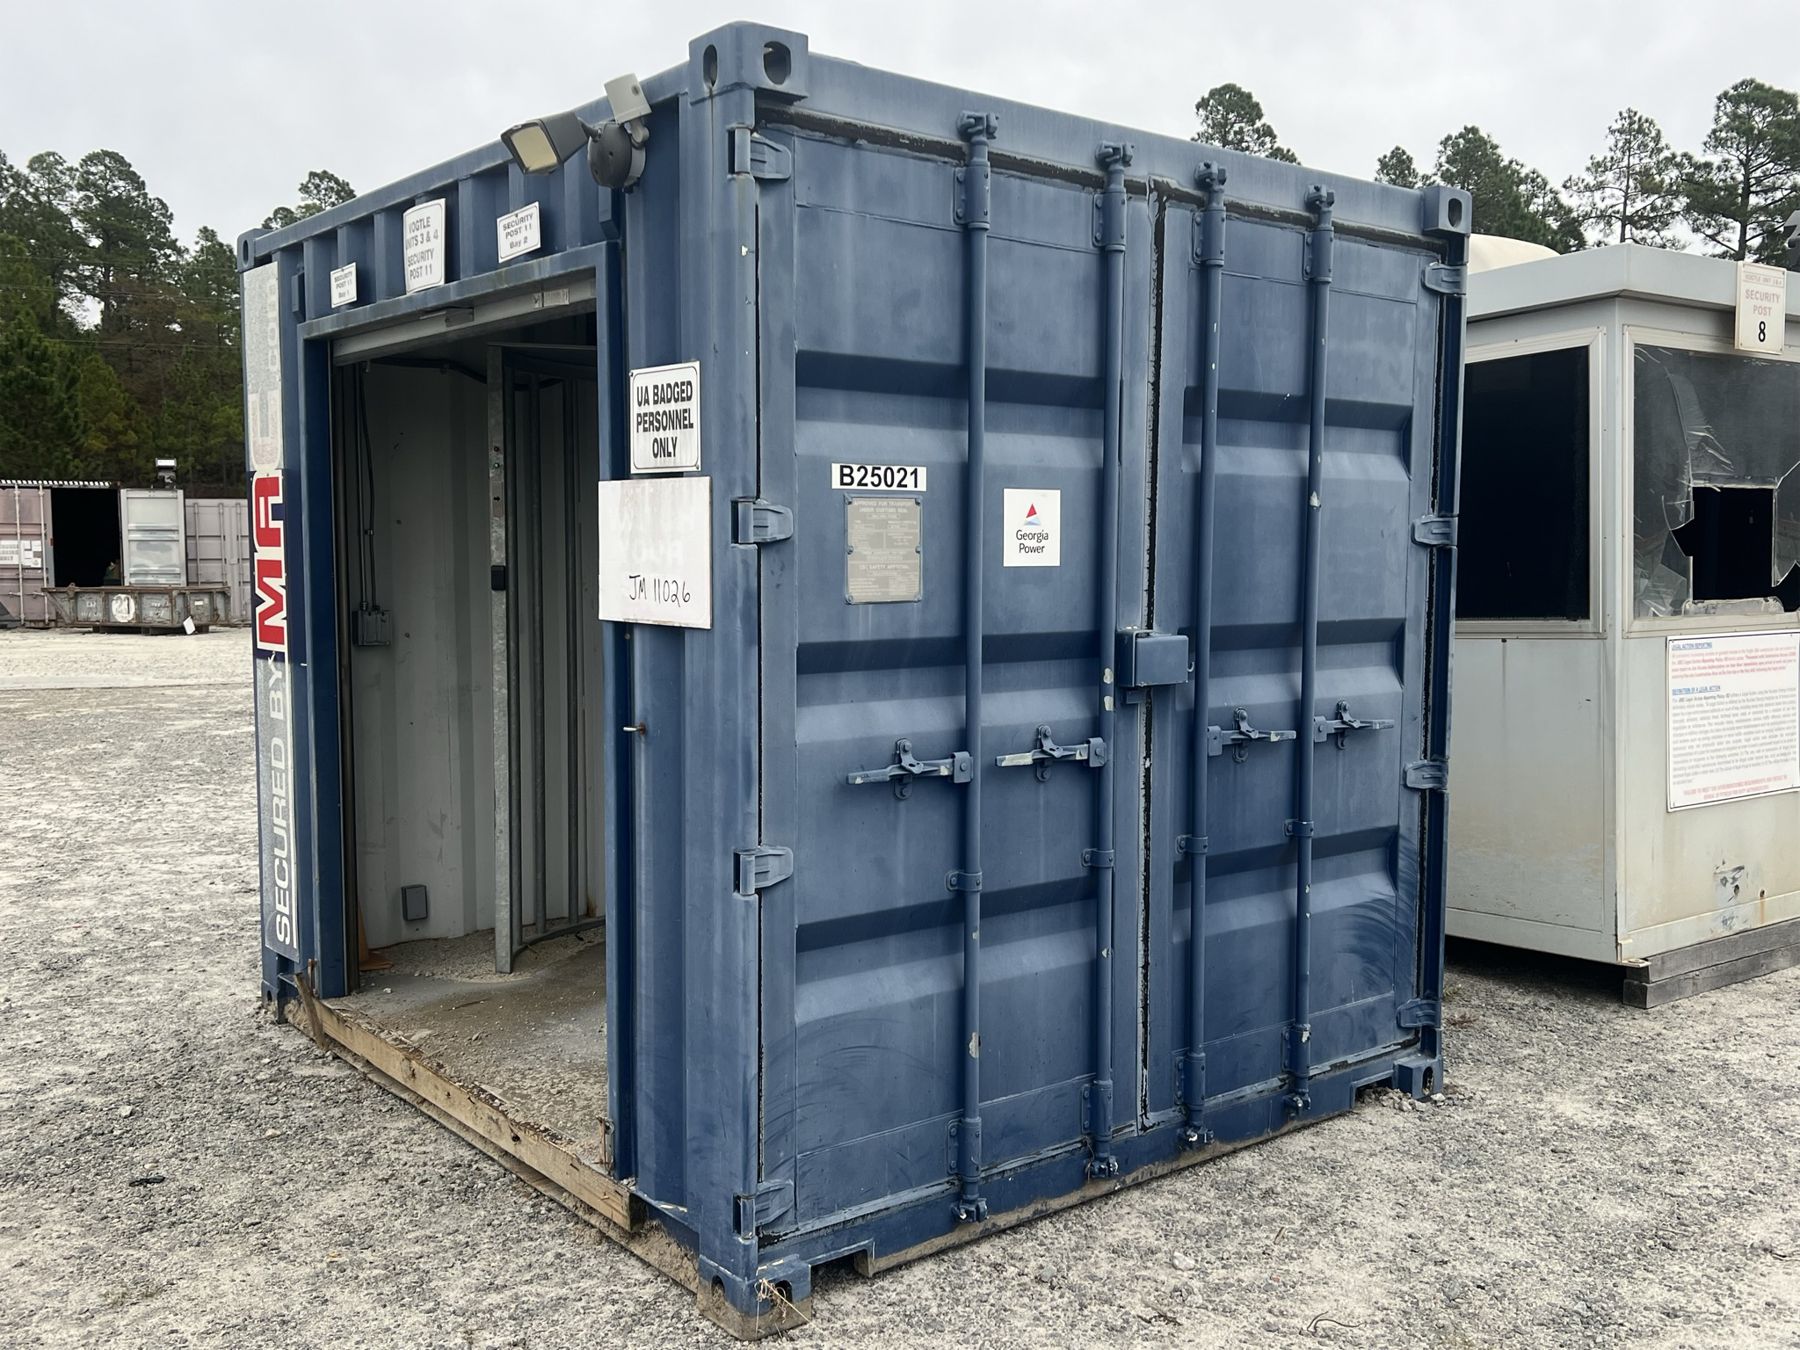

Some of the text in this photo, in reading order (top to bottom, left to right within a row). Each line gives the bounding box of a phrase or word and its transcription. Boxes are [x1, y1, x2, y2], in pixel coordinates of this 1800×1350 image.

[408, 216, 431, 233] VOGTLE
[503, 213, 533, 231] SECURITY
[420, 233, 424, 244] 3
[426, 231, 431, 244] &
[433, 229, 439, 240] 4
[505, 223, 532, 240] POST 11
[523, 236, 528, 244] 2
[408, 248, 434, 267] SECURITY
[410, 264, 432, 280] POST 11
[1745, 289, 1780, 303] SECURITY
[1753, 304, 1772, 317] POST
[1758, 320, 1766, 343] 8
[636, 380, 693, 407] UA BADGED
[636, 408, 694, 433] PERSONNEL
[652, 437, 677, 459] ONLY
[839, 465, 919, 489] B25021
[1016, 529, 1049, 544] Georgia
[1019, 543, 1045, 554] Power
[629, 575, 691, 607] JM 11026
[268, 655, 287, 721] BY
[270, 736, 291, 946] SECURED
